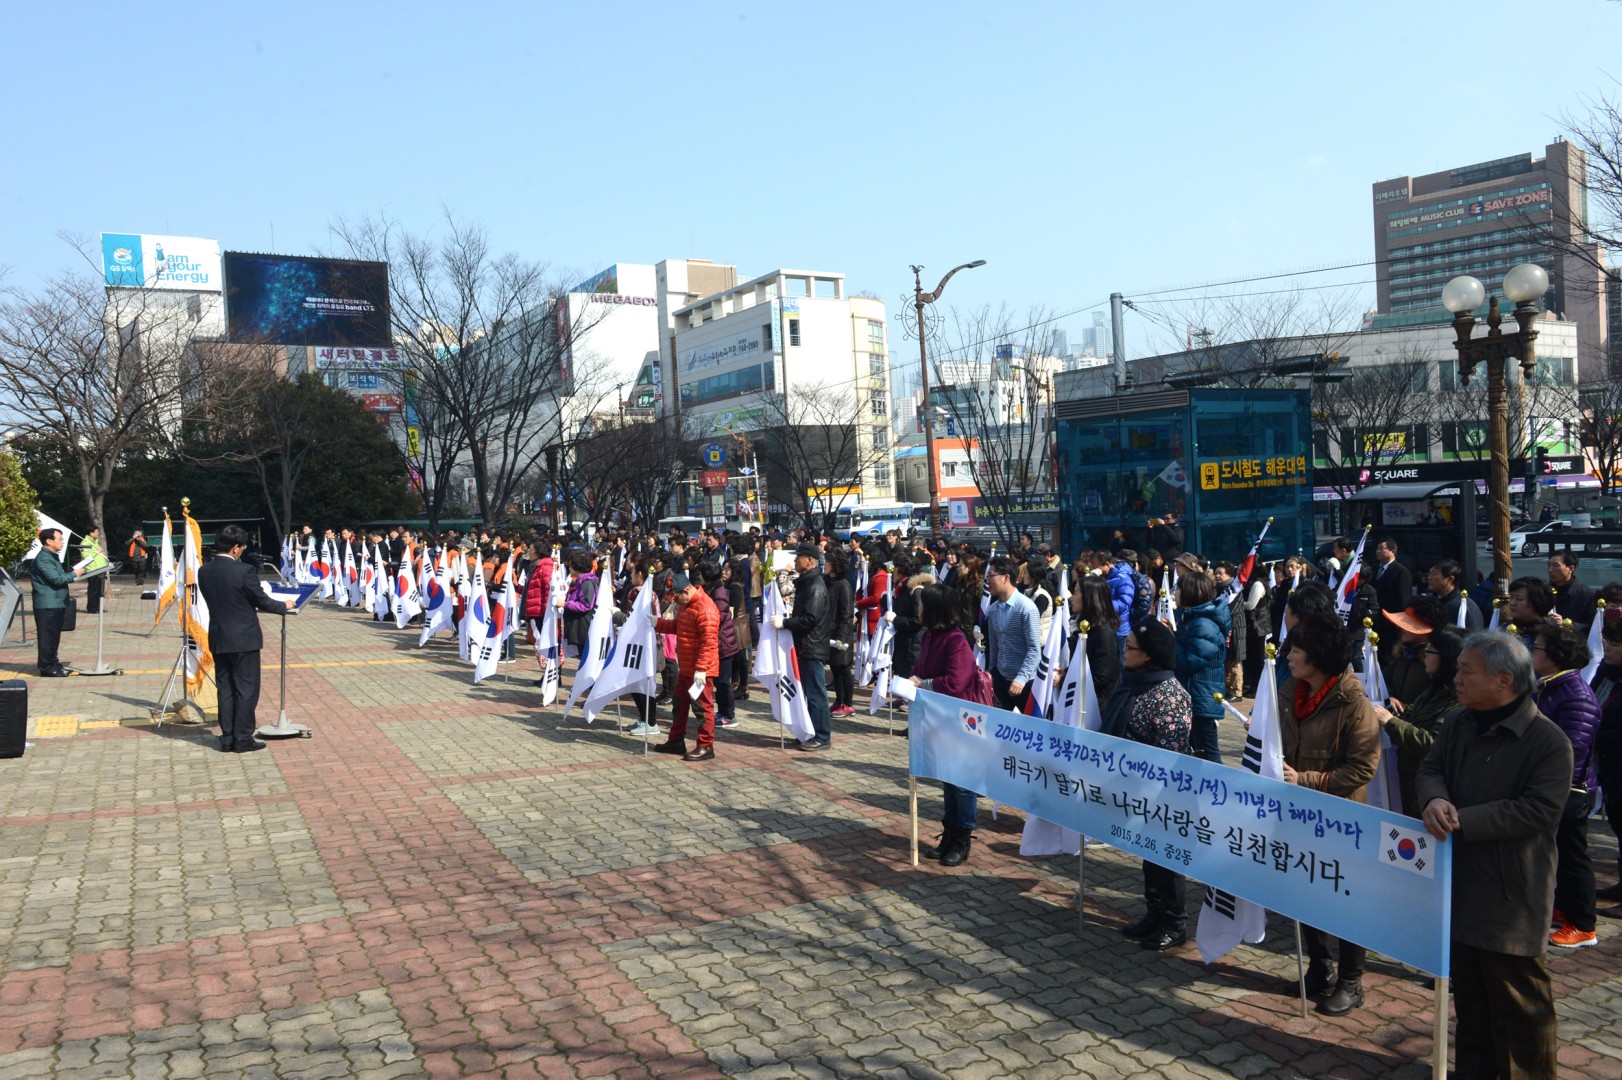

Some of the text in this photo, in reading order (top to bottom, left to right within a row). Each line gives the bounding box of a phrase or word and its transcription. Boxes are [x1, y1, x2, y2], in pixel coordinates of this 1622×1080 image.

[1484, 197, 1514, 212] SAVE
[1515, 190, 1548, 206] ZONE
[1420, 211, 1444, 222] MUSIC
[1445, 208, 1465, 217] CLUB
[167, 254, 189, 263] am
[166, 262, 201, 273] your
[157, 272, 209, 284] Energy
[591, 293, 658, 307] MEGABOX
[1221, 455, 1306, 478] 도시철도 해운대역
[1551, 461, 1572, 472] SQUARE
[1374, 469, 1419, 481] SQUARE
[994, 723, 1043, 752] 2015년은
[1049, 736, 1115, 773] 광복70주년
[1234, 790, 1282, 822] 기념의
[1288, 801, 1363, 850] 해입니다
[1003, 755, 1350, 897] 태극기 달기로 나라사랑을 실천합시다.
[1110, 824, 1193, 866] 2015.2.26. 중2동
